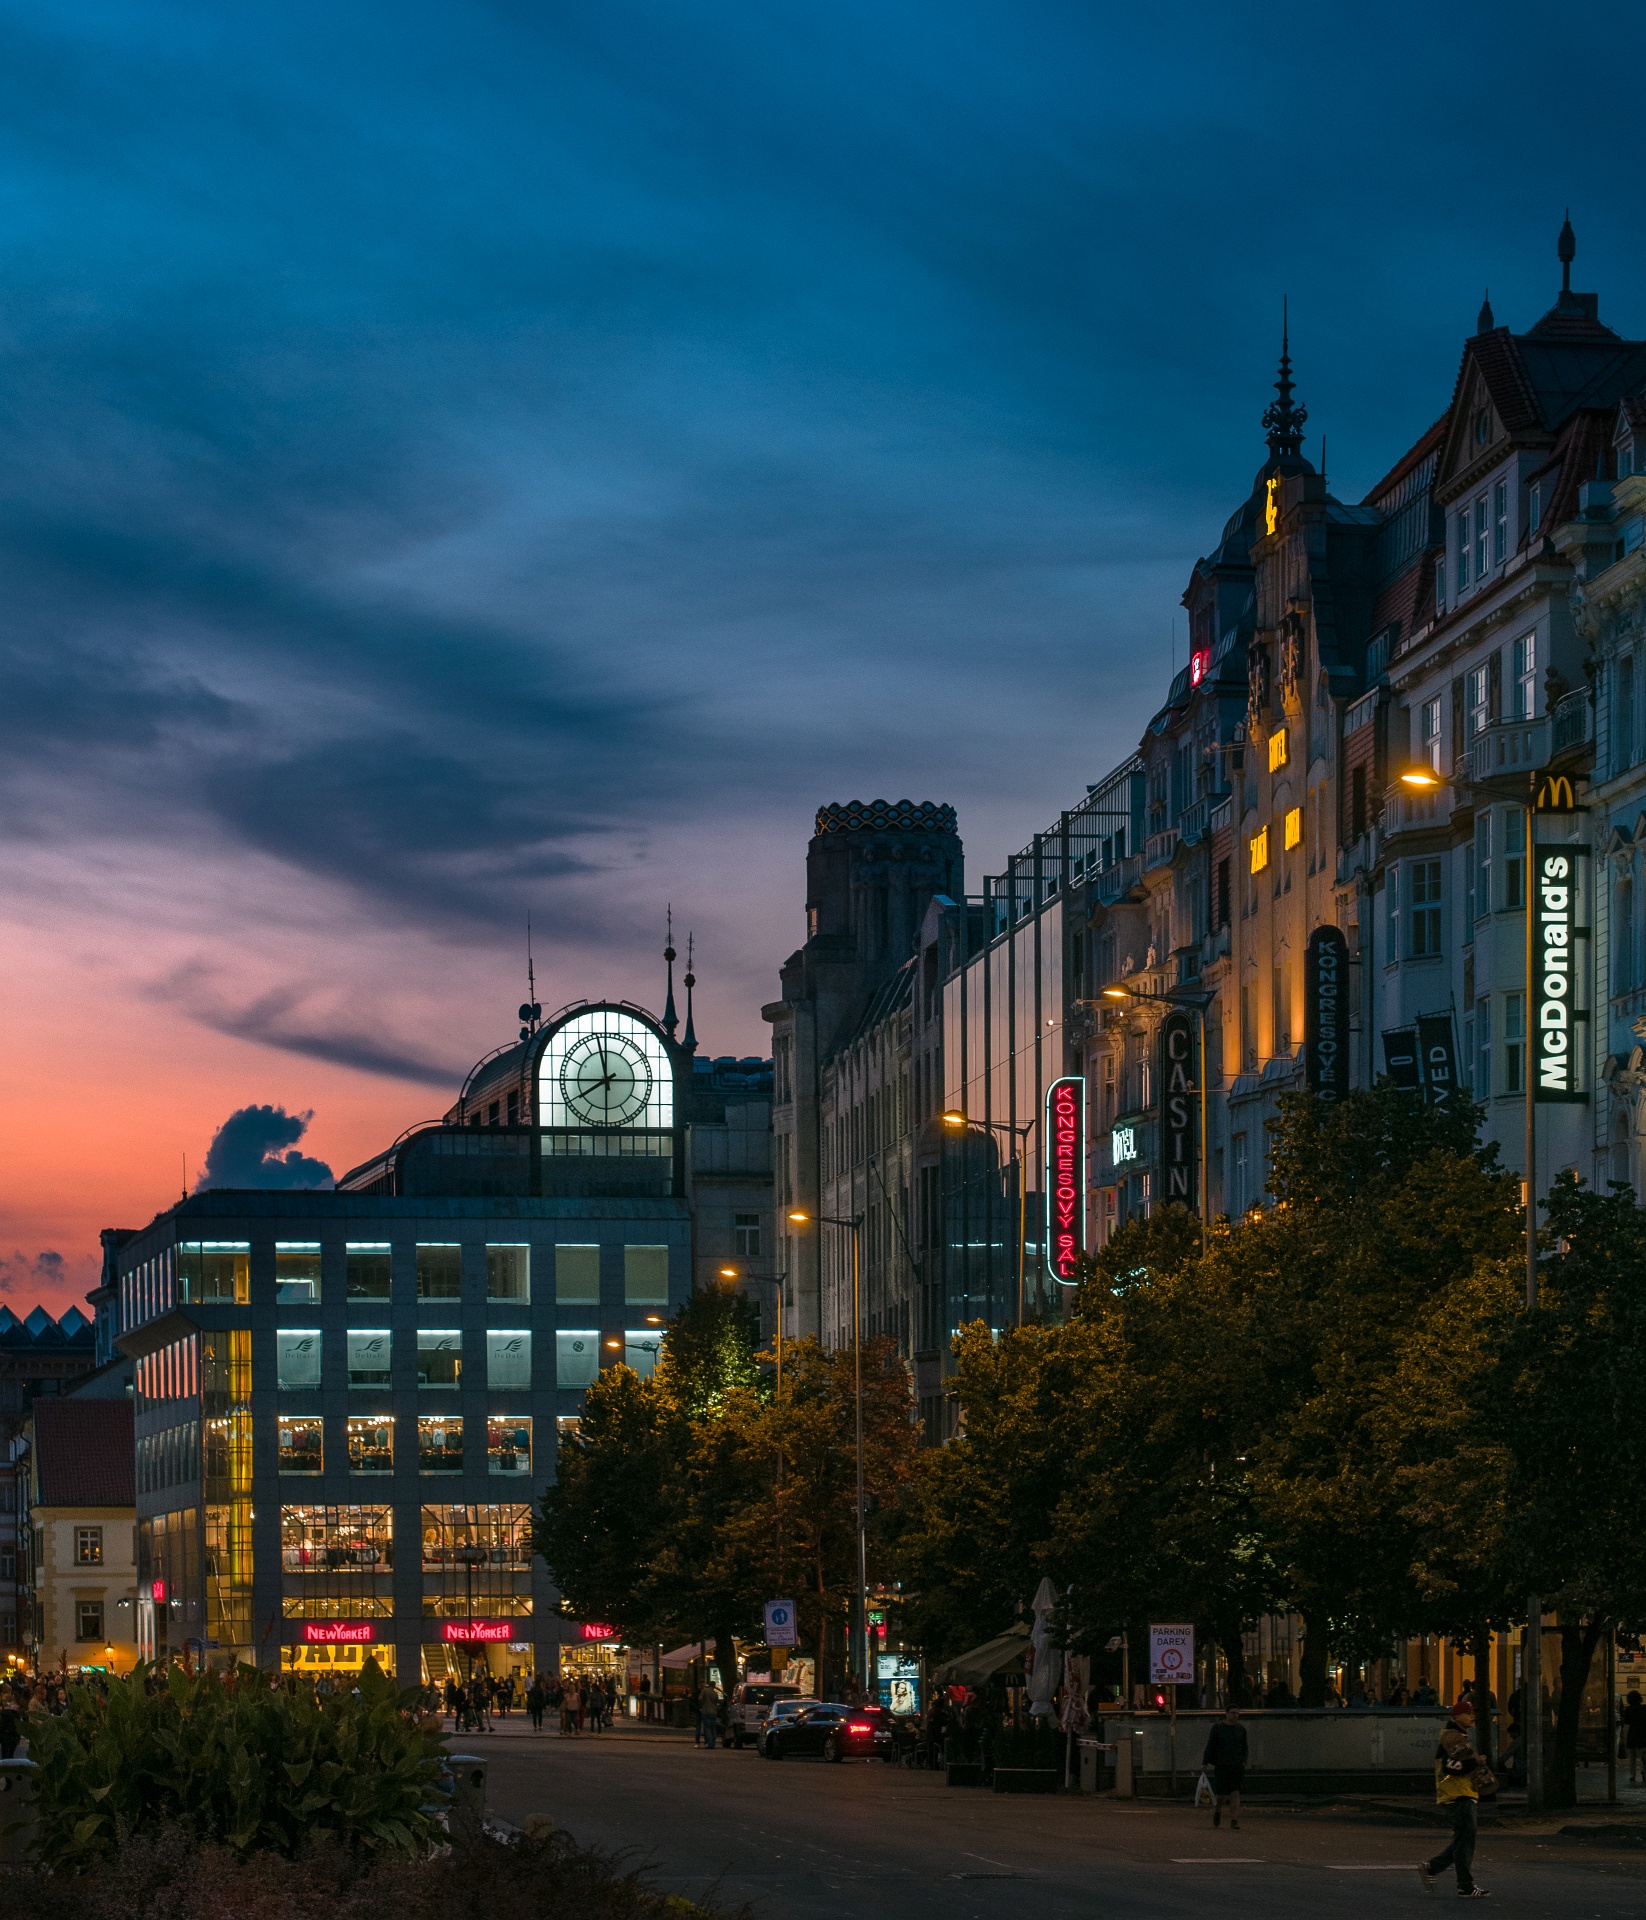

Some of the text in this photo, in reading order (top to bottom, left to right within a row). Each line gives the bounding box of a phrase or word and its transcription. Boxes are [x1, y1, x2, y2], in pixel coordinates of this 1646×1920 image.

[1540, 856, 1568, 1090] McDonald's
[1167, 1029, 1190, 1197] CASIN
[1429, 1046, 1450, 1104] VED
[1056, 1087, 1075, 1229] KONGRESOVÝ
[1152, 1628, 1191, 1636] PARKING
[1157, 1637, 1186, 1646] DAREX
